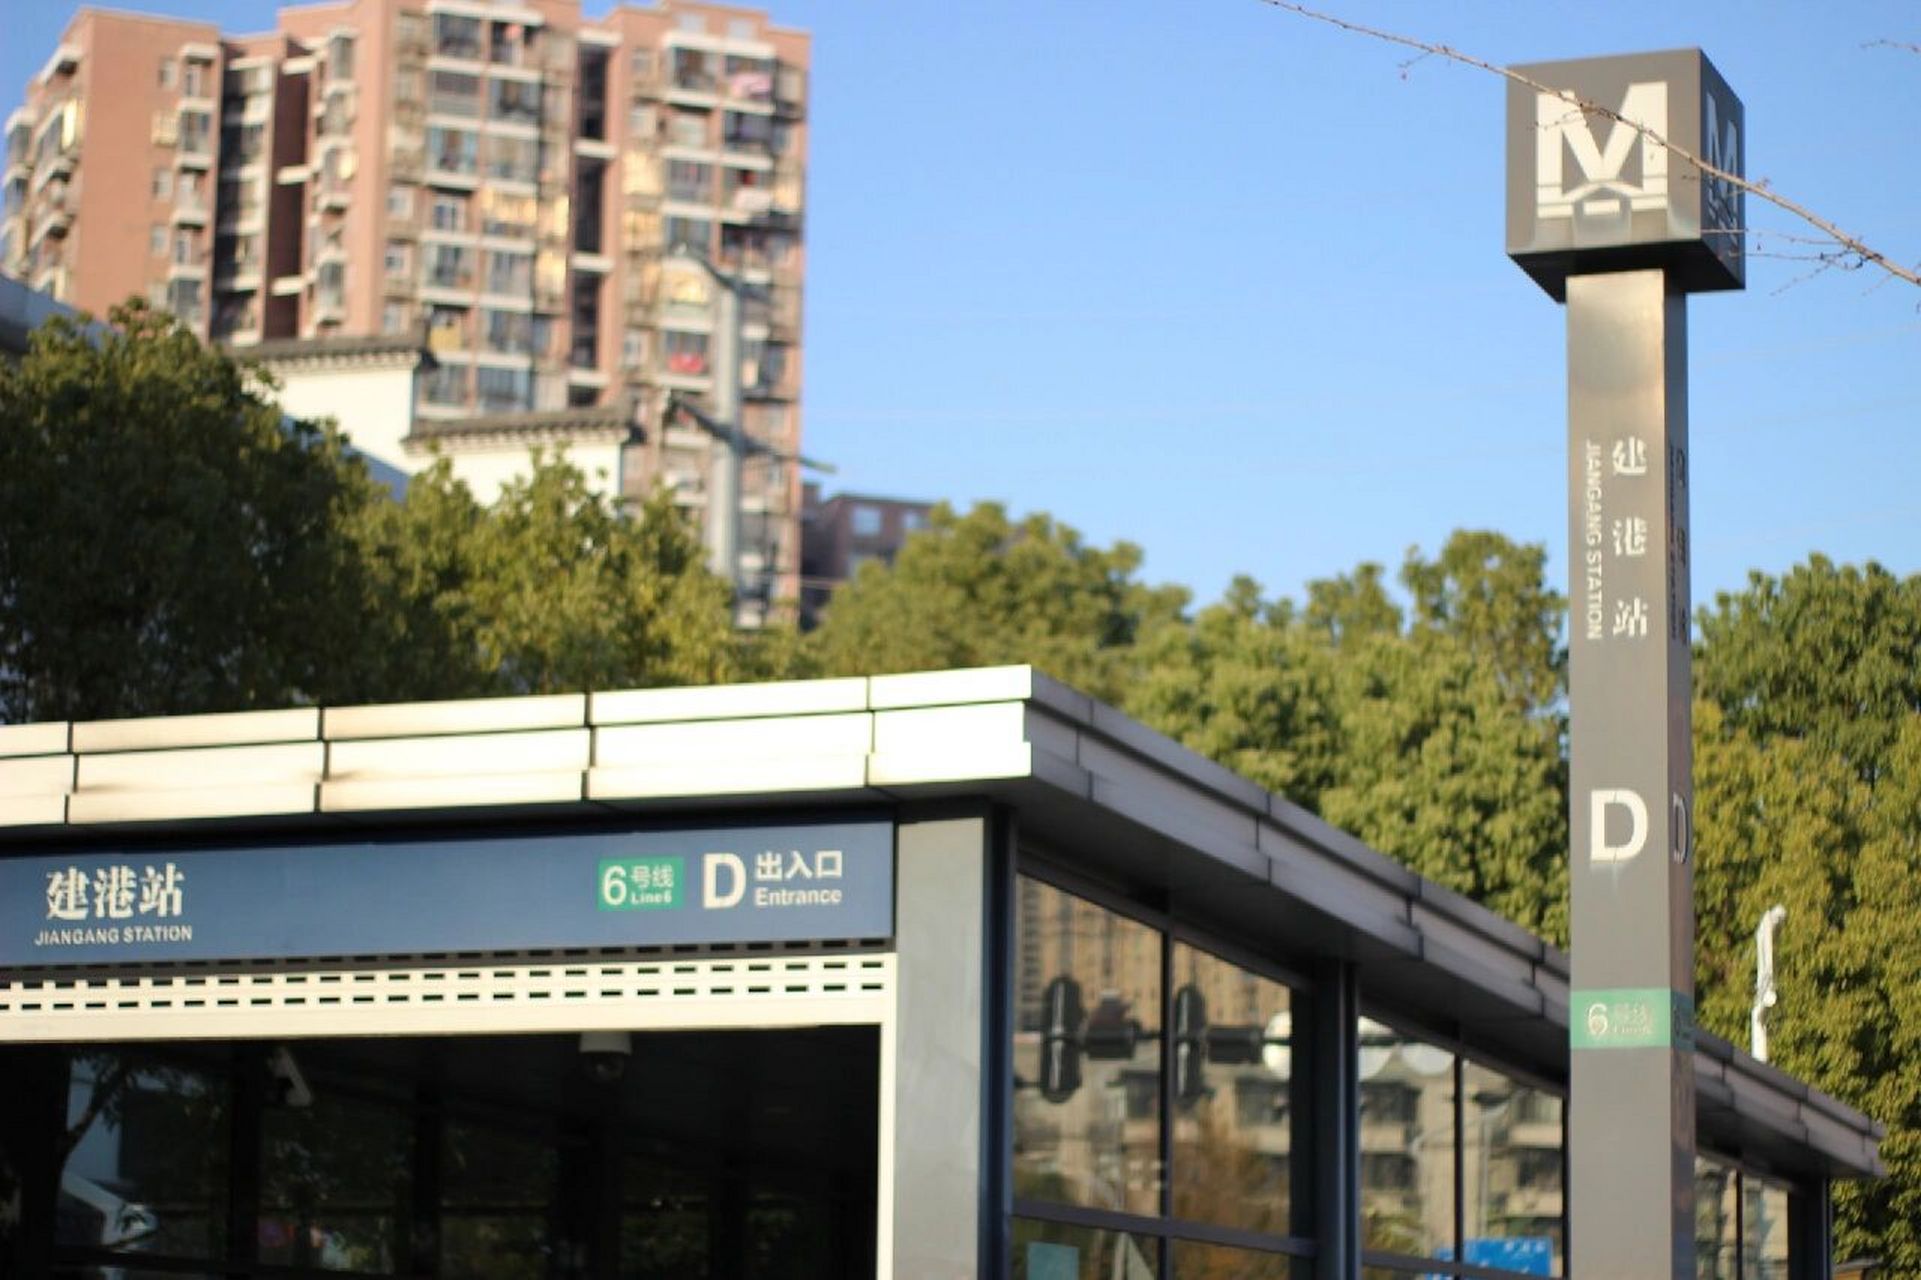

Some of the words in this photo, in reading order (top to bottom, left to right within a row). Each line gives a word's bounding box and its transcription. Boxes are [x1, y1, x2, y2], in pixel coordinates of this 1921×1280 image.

[1586, 439, 1602, 546] JIANGANG
[1586, 551, 1602, 640] STATION
[1590, 788, 1648, 861] D
[47, 863, 184, 919] 建港站
[603, 866, 627, 905] 6
[631, 865, 674, 888] 号线
[703, 853, 747, 908] D
[755, 851, 842, 880] 出入口
[754, 888, 842, 905] Entrance
[35, 929, 119, 945] JIANGANG
[123, 926, 192, 943] STATION
[1588, 1003, 1608, 1035] 6
